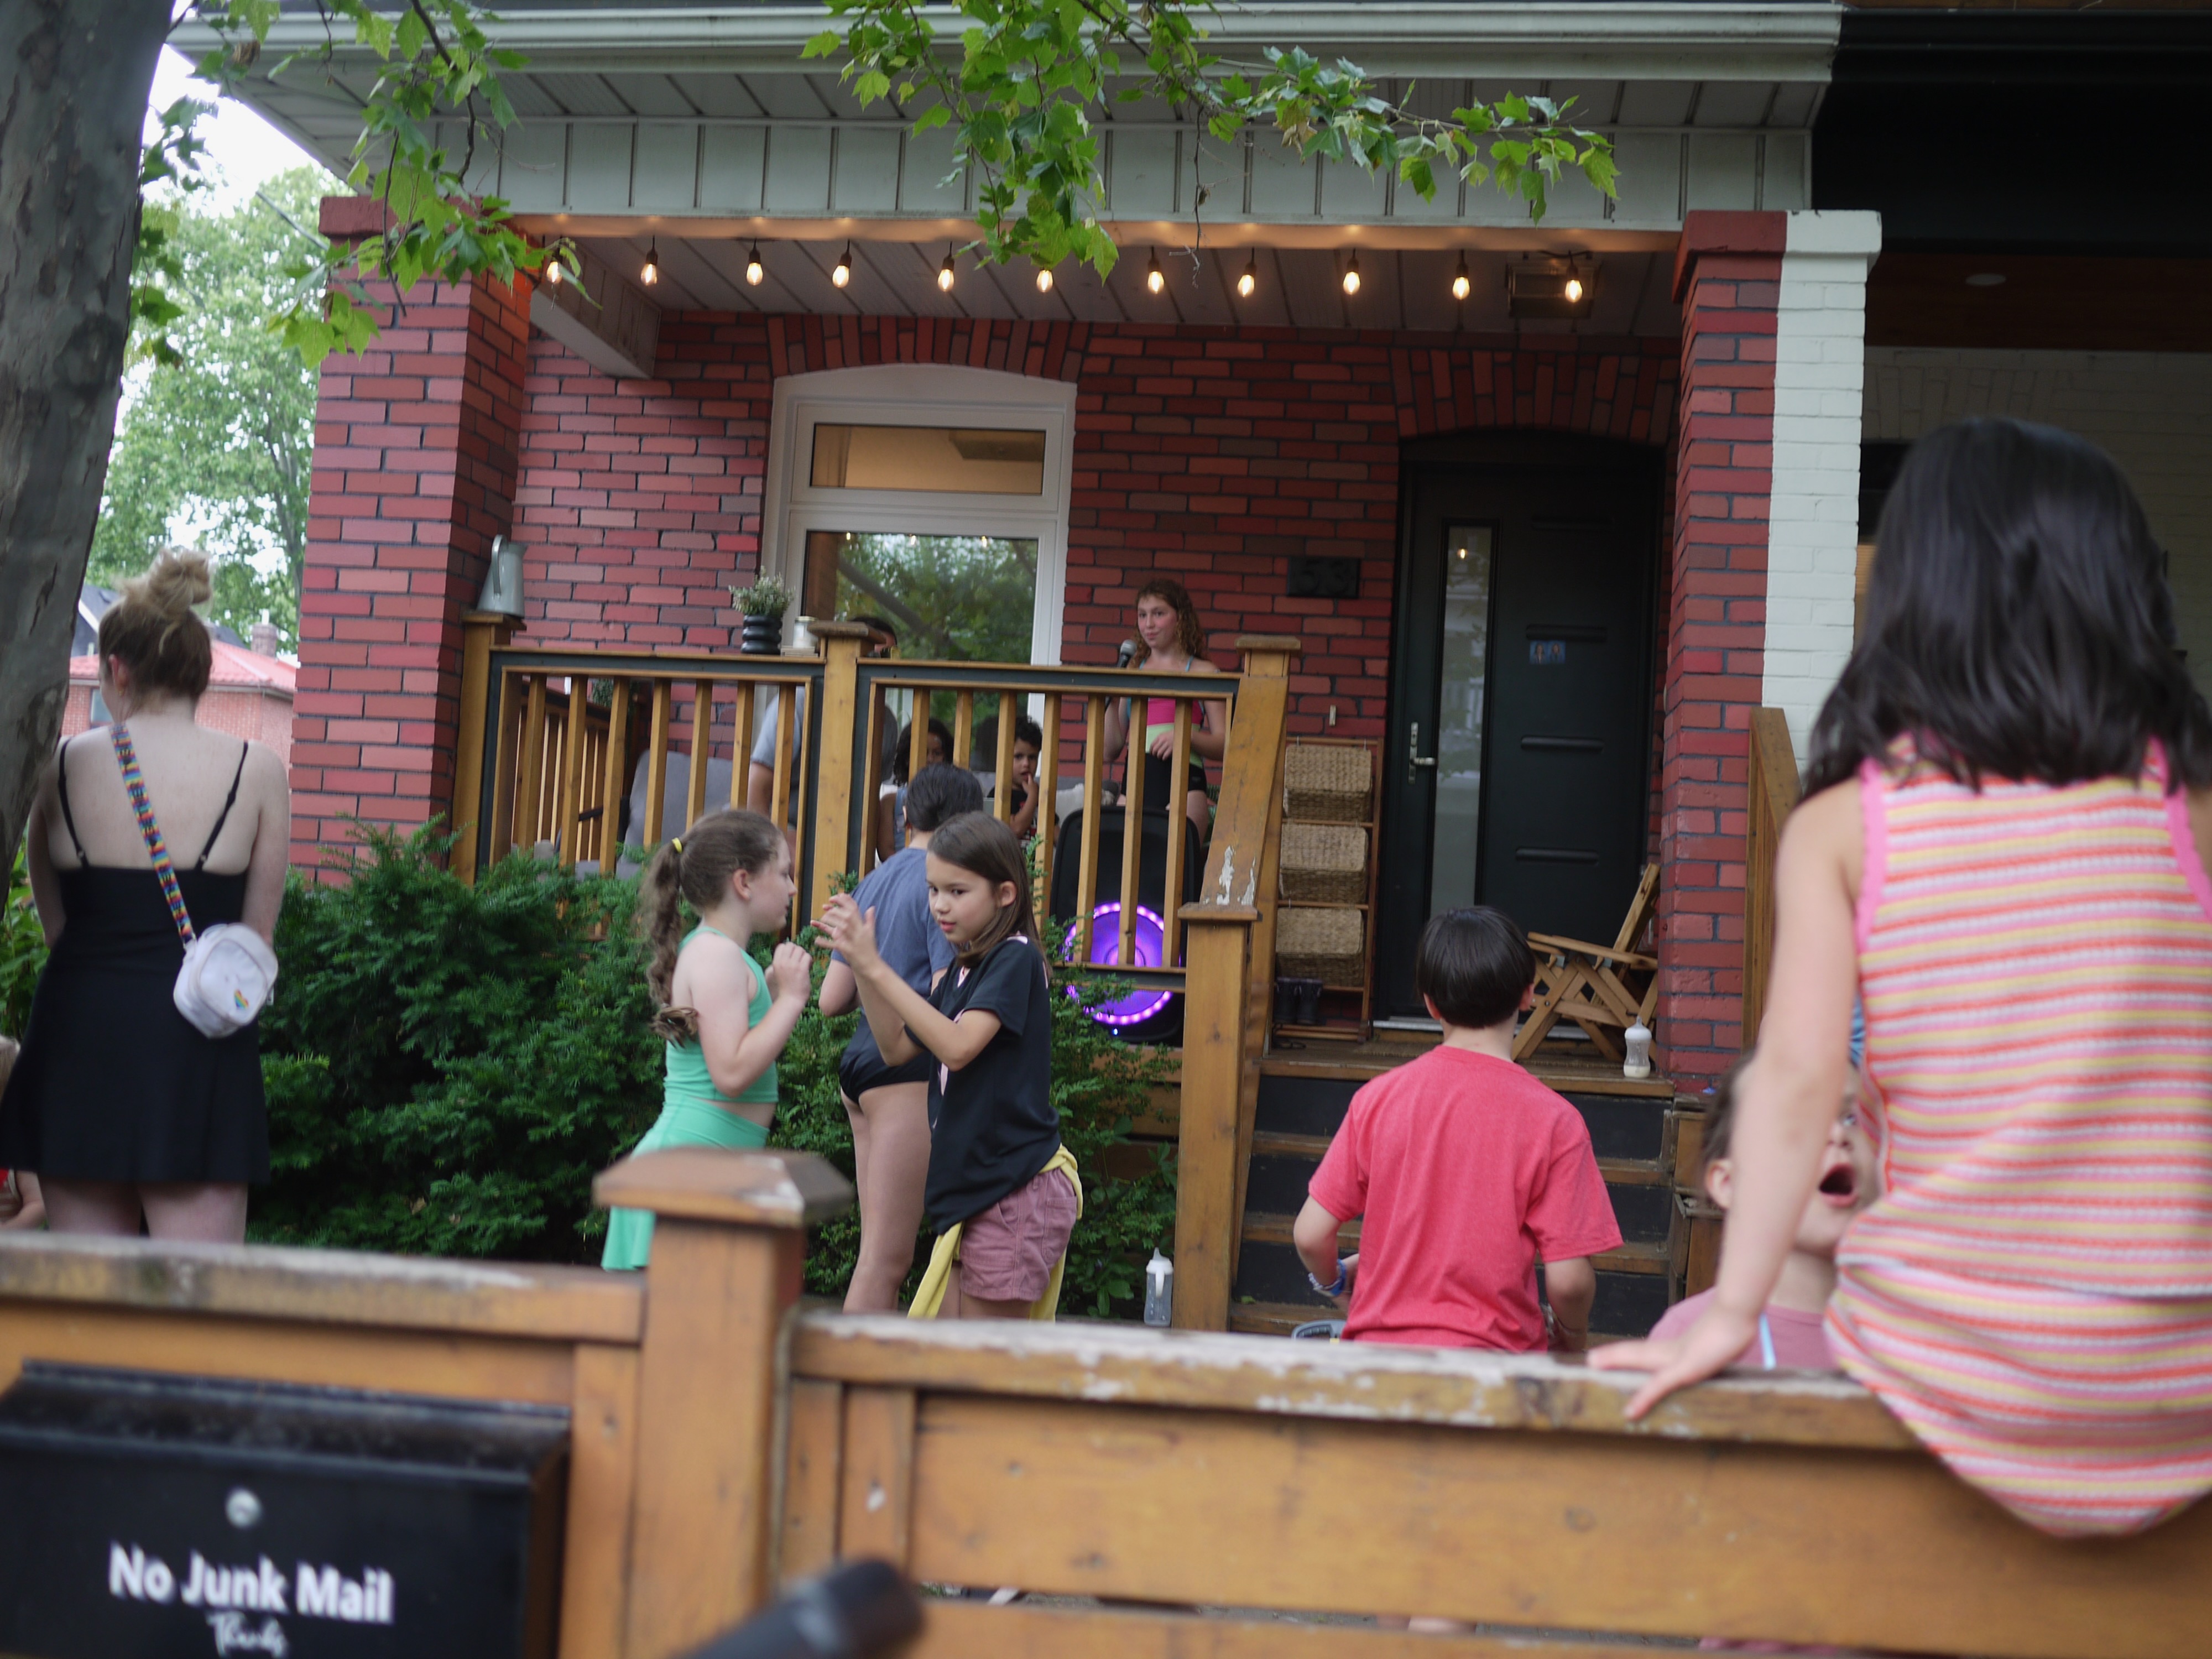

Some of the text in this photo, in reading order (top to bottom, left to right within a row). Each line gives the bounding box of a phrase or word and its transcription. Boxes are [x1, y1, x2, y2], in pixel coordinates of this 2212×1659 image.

[108, 1543, 394, 1624] No Junk Mail
